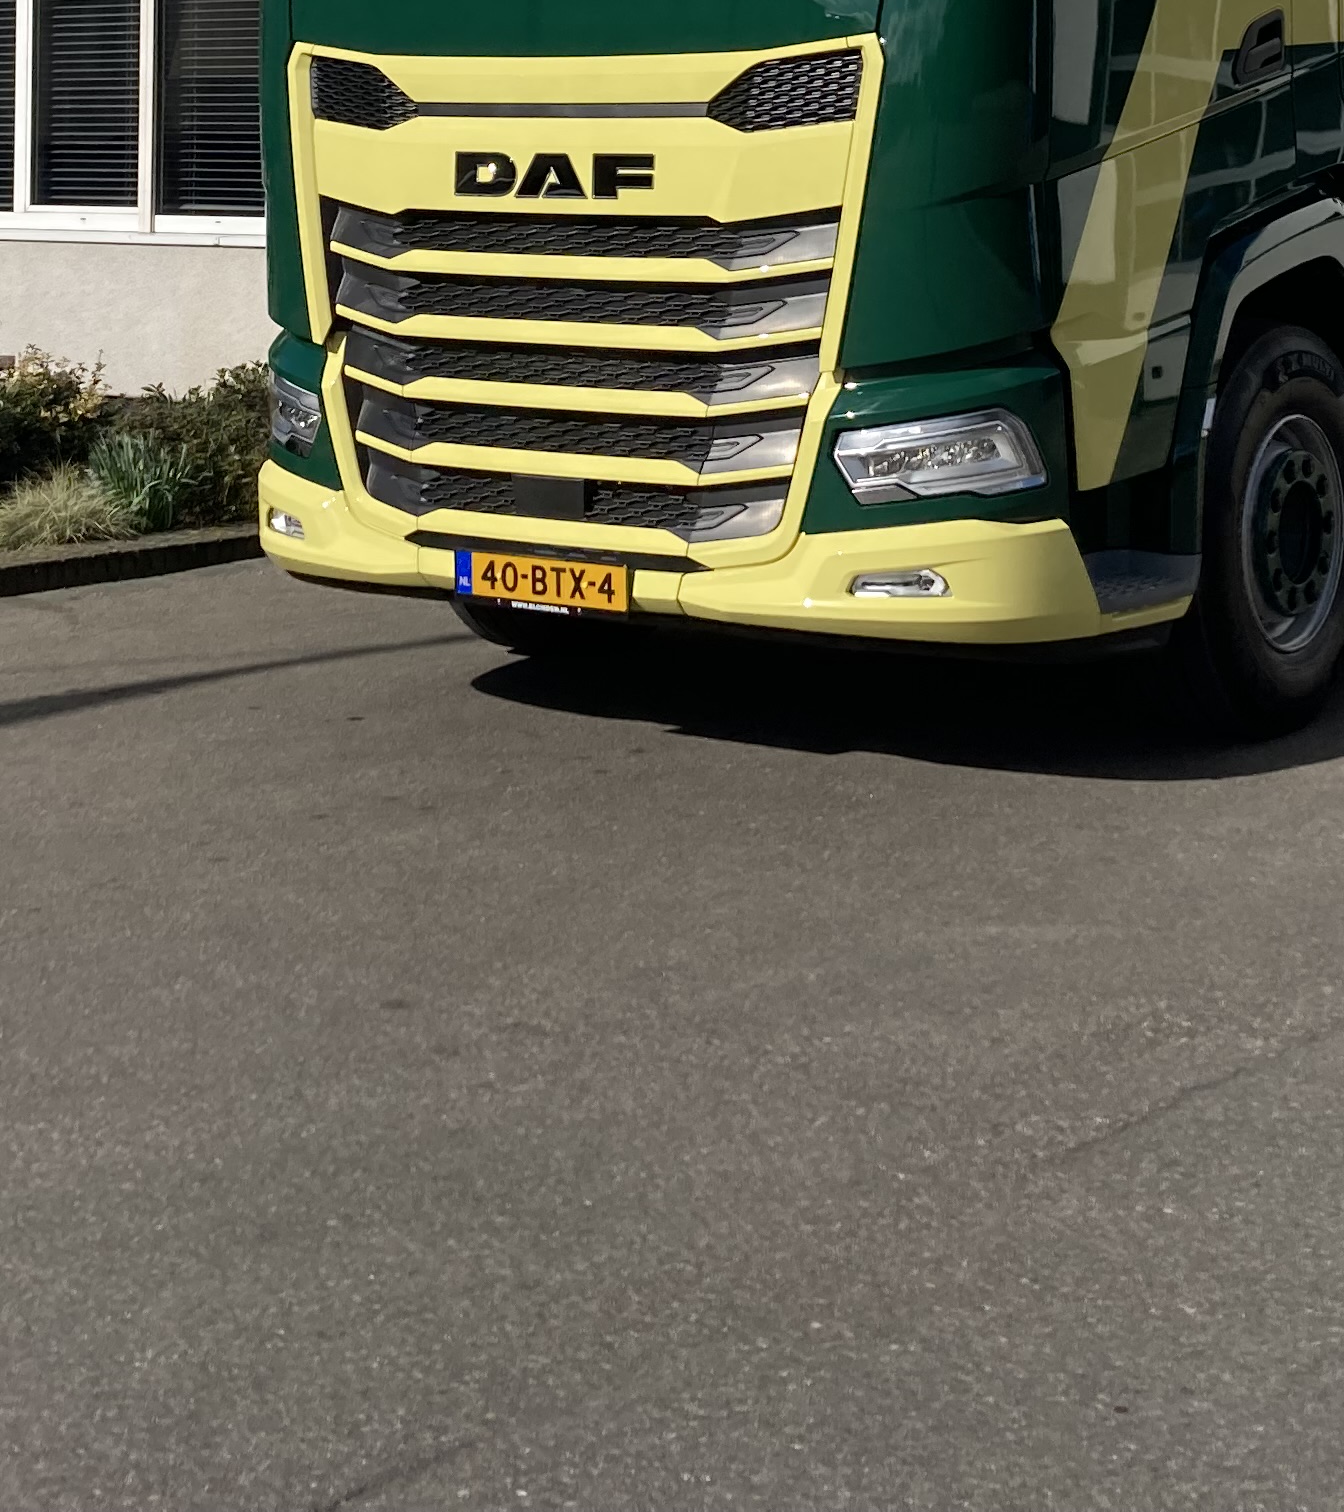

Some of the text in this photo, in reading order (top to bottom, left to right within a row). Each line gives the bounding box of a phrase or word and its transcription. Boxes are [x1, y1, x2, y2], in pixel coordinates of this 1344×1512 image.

[454, 151, 655, 199] DAF
[458, 575, 471, 587] NL
[481, 559, 616, 604] 40-BTX-4
